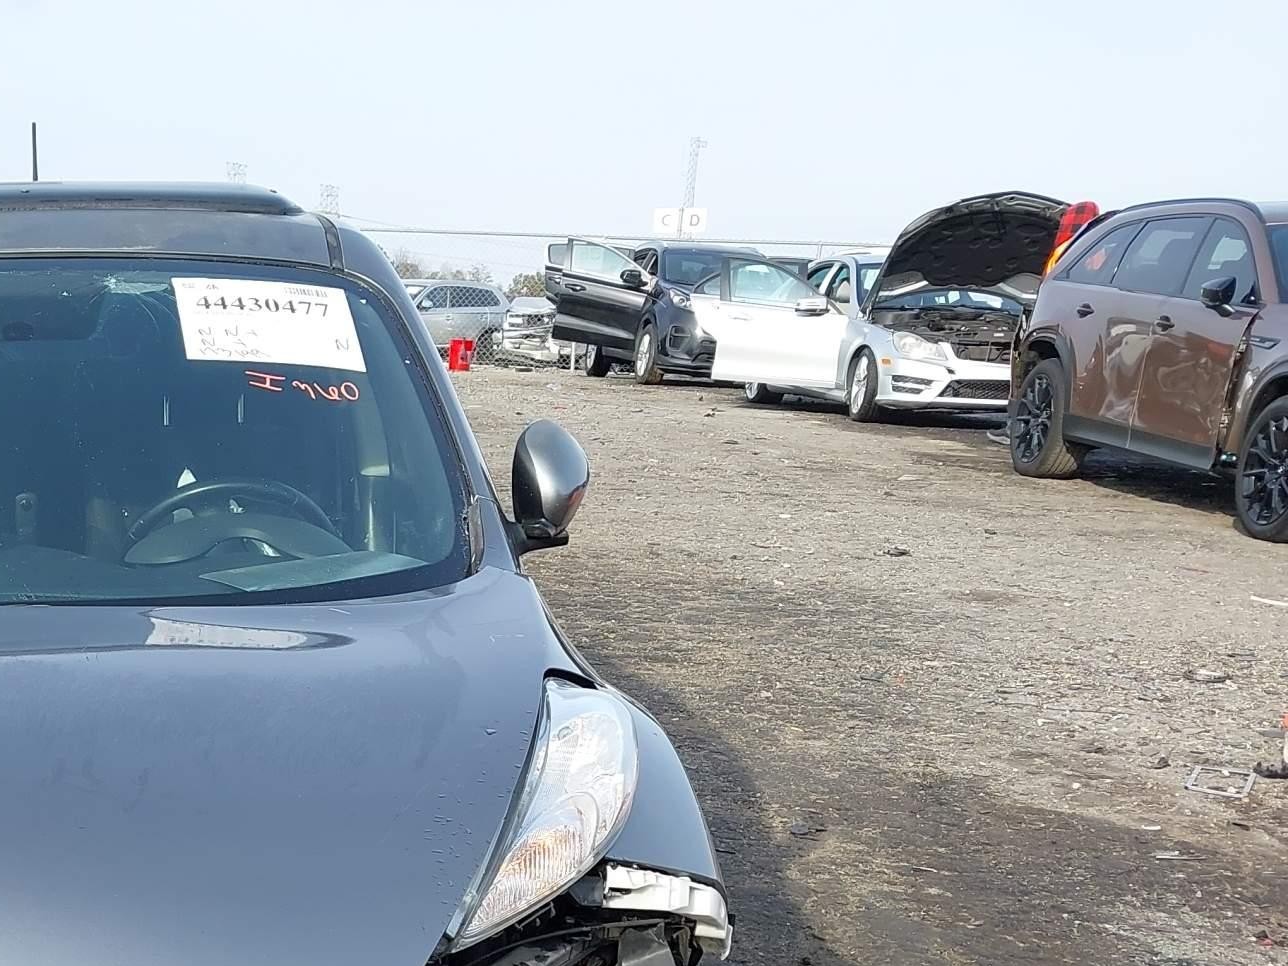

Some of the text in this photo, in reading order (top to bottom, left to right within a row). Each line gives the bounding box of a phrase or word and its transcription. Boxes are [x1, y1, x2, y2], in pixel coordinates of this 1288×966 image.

[662, 214, 672, 226] C
[689, 214, 700, 226] D
[196, 295, 328, 317] 44430477
